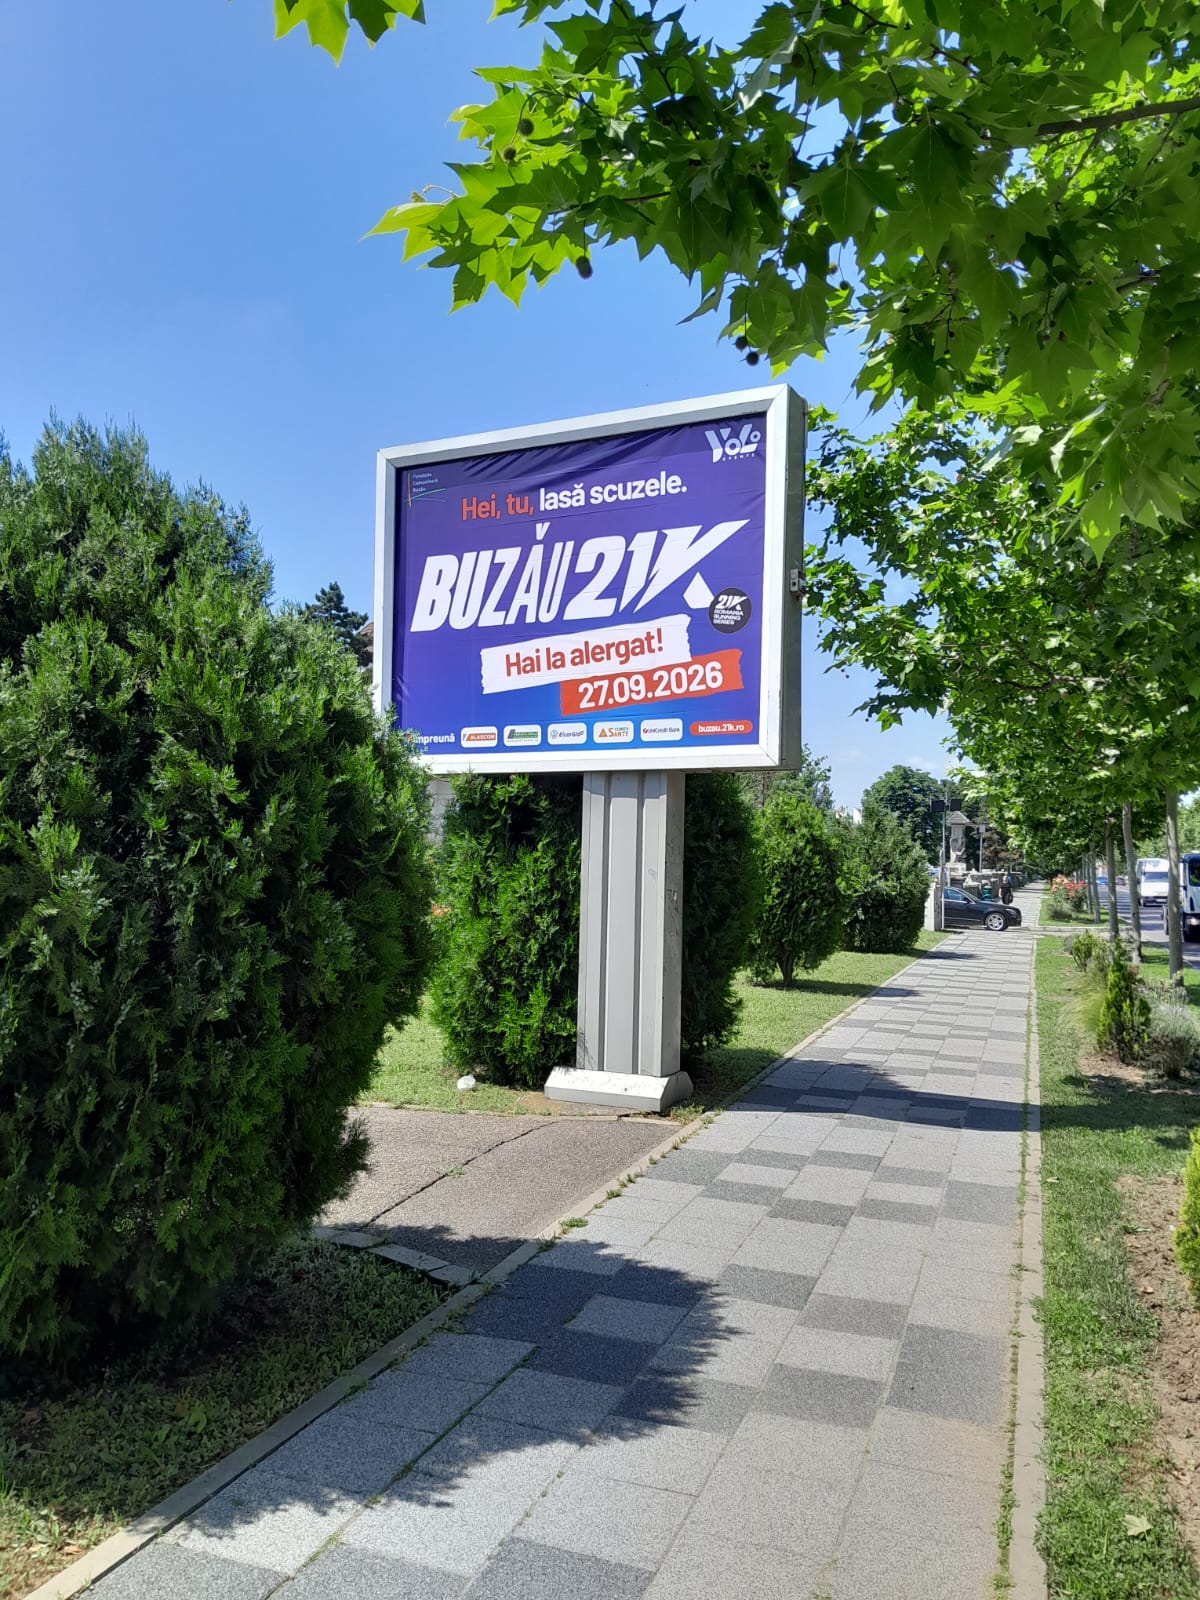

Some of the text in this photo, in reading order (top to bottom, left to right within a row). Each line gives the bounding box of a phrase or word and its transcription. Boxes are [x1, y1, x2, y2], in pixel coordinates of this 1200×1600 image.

[462, 471, 687, 520] Hei, tu, lasă scuzele.
[410, 519, 750, 632] BUZĂU 21K
[715, 595, 747, 610] 21K
[506, 628, 664, 677] Hai la alergat!
[578, 661, 723, 709] 27.09.2026
[414, 733, 455, 745] mpreună
